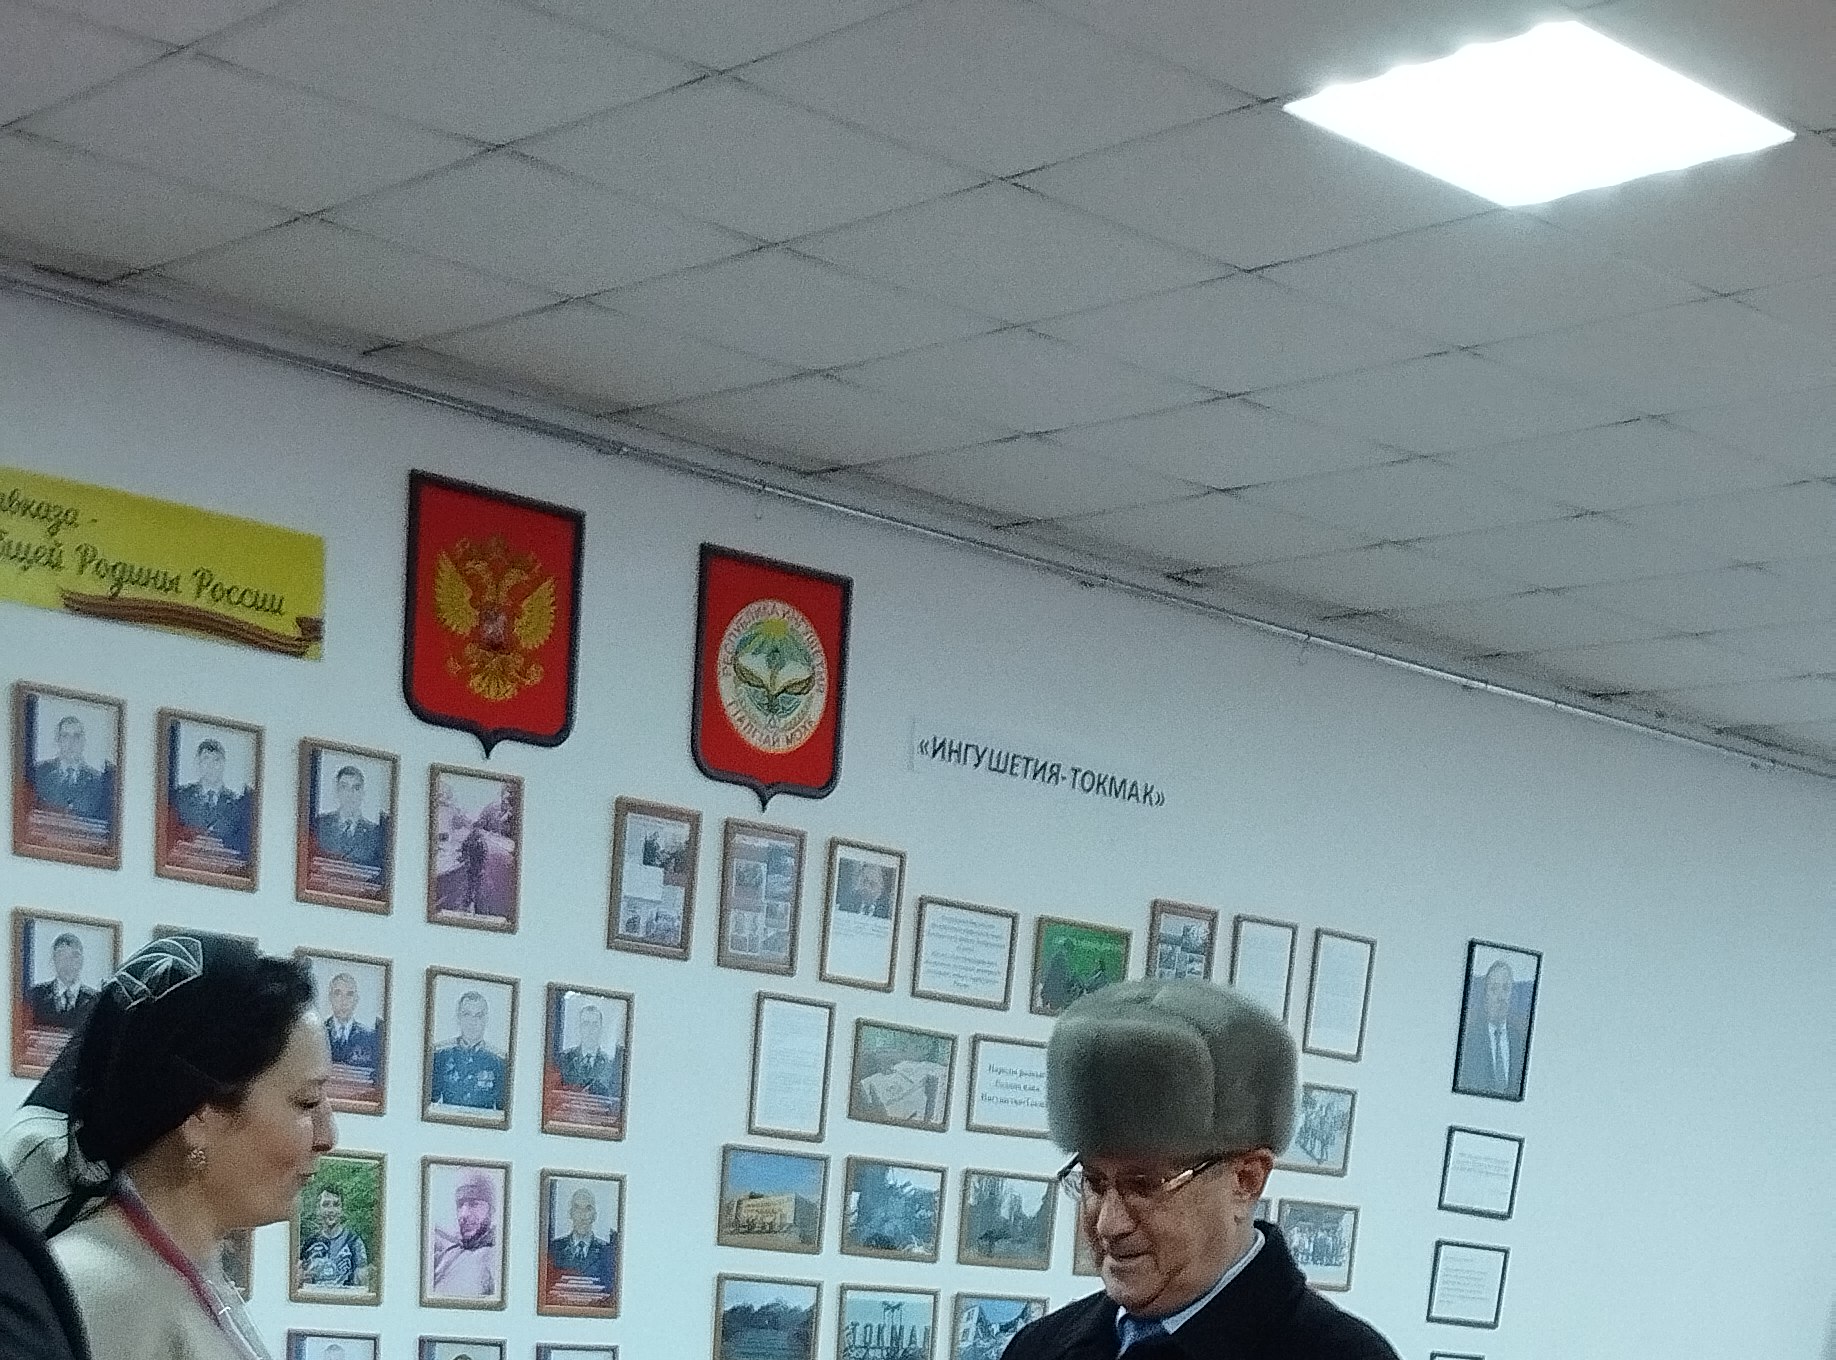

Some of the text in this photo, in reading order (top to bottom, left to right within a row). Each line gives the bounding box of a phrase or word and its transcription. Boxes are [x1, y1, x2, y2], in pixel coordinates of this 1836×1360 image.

[75, 543, 182, 599] Родины
[191, 566, 285, 615] России
[918, 735, 1167, 808] «ИНГУШЕТИЯ-ТОКМАК»
